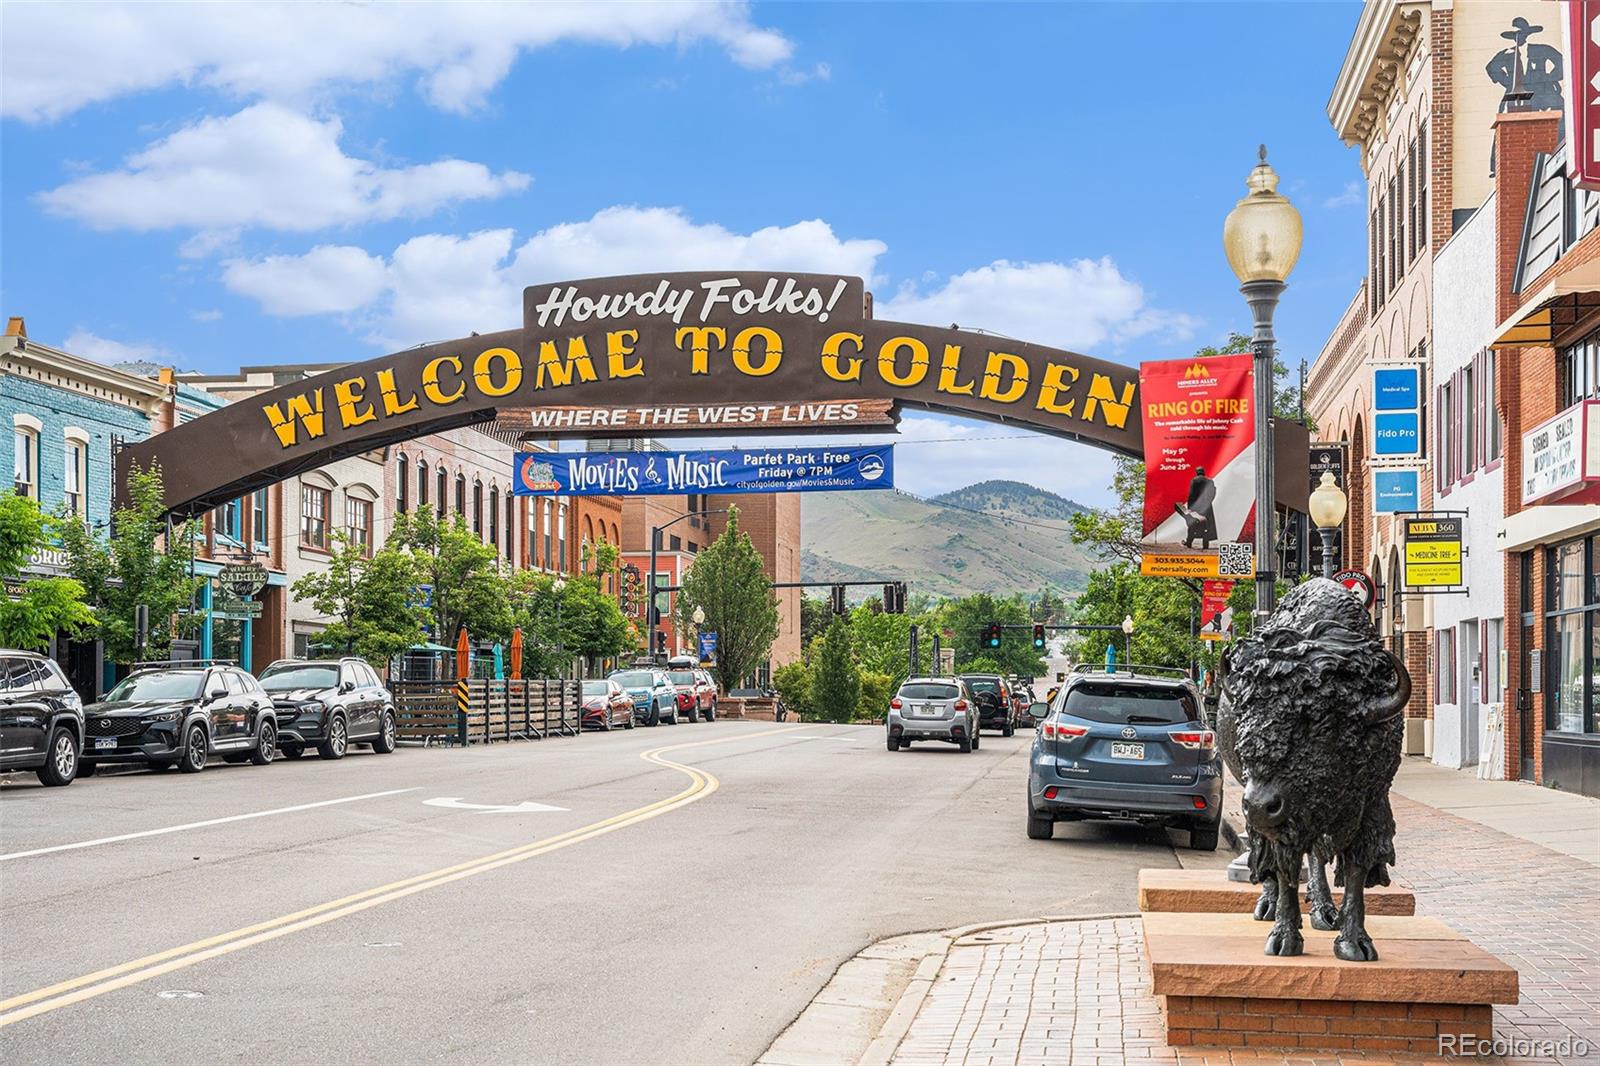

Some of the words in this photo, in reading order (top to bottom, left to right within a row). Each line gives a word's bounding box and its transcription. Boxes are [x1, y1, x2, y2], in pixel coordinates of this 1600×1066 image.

[536, 280, 694, 328] Howdy
[700, 277, 847, 323] Folks!
[262, 328, 645, 448] WELCOME
[675, 326, 784, 376] TO
[821, 331, 1137, 429] GOLDEN
[1147, 400, 1188, 418] RING
[1190, 399, 1213, 415] OF
[1215, 398, 1249, 414] FIRE
[530, 409, 628, 427] WHERE
[636, 408, 690, 425] THE
[698, 406, 776, 423] WEST
[782, 403, 859, 421] LIVES
[1377, 429, 1398, 438] Fido
[1400, 429, 1416, 437] Pro
[1162, 448, 1178, 456] May
[743, 453, 783, 466] Parfet
[787, 453, 815, 465] Park
[823, 452, 850, 463] Free
[758, 467, 793, 479] Friday
[796, 467, 807, 477] @
[810, 466, 833, 476] 7PM
[1438, 523, 1455, 532] 360
[1415, 551, 1439, 559] MEDICINE
[1150, 566, 1209, 574] minersalley.com
[1336, 571, 1352, 582] FIDO
[1351, 571, 1366, 581] PRO
